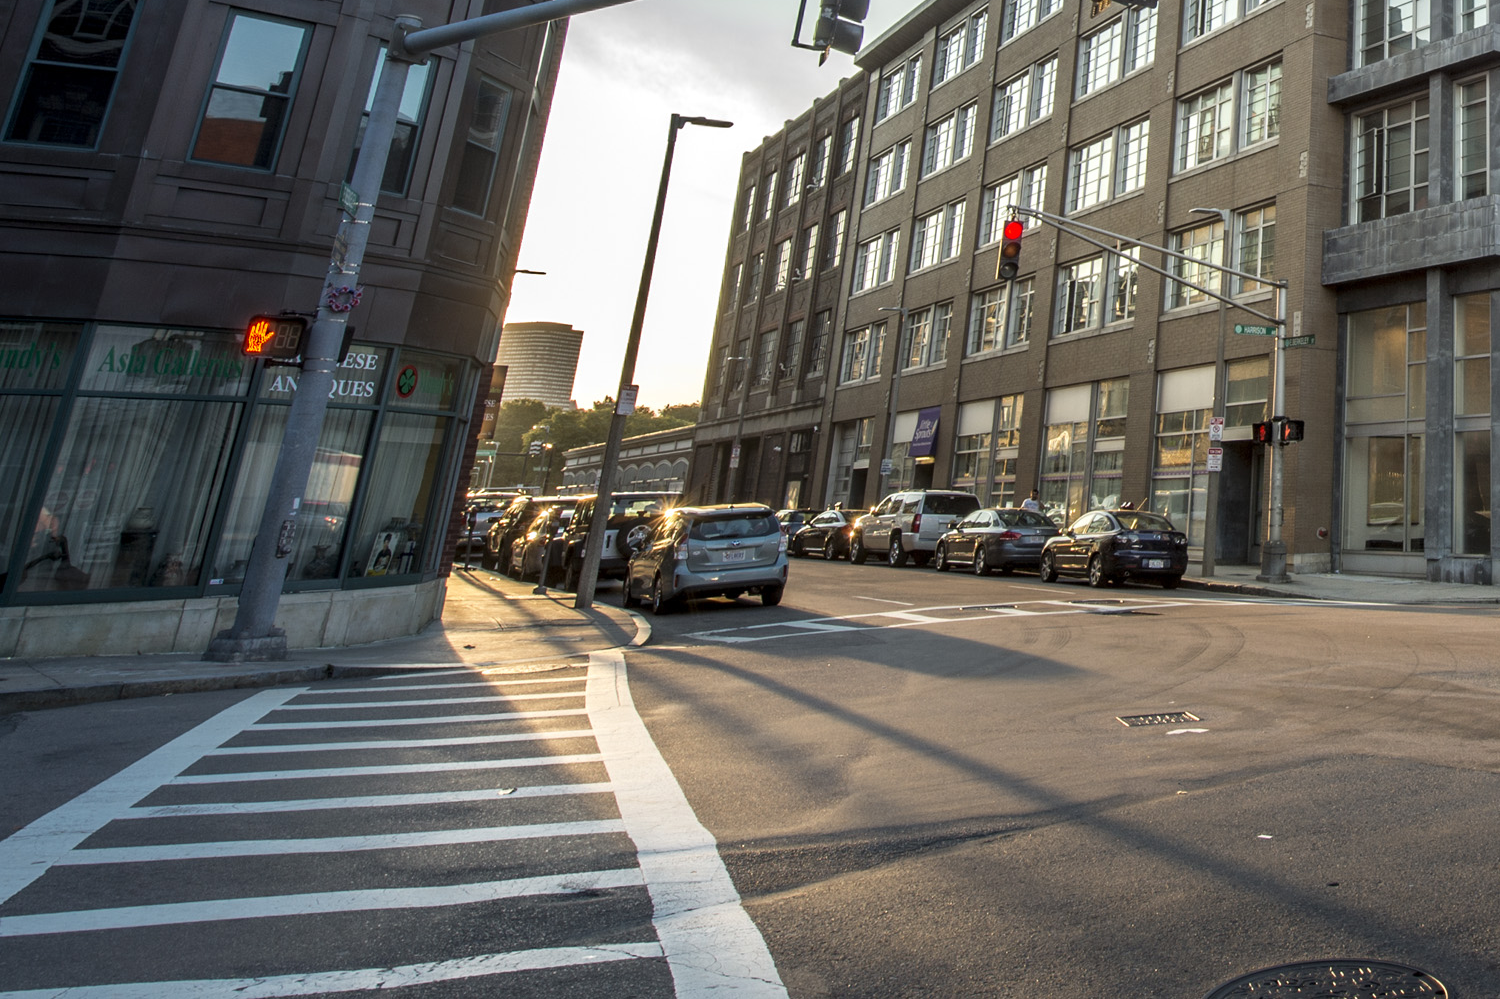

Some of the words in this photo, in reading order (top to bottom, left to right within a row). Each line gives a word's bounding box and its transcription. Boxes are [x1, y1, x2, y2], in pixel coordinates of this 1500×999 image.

[1244, 326, 1267, 335] HARRISON
[98, 345, 145, 374] Asia
[153, 348, 244, 379] Galleries
[269, 375, 375, 399] ANQUES
